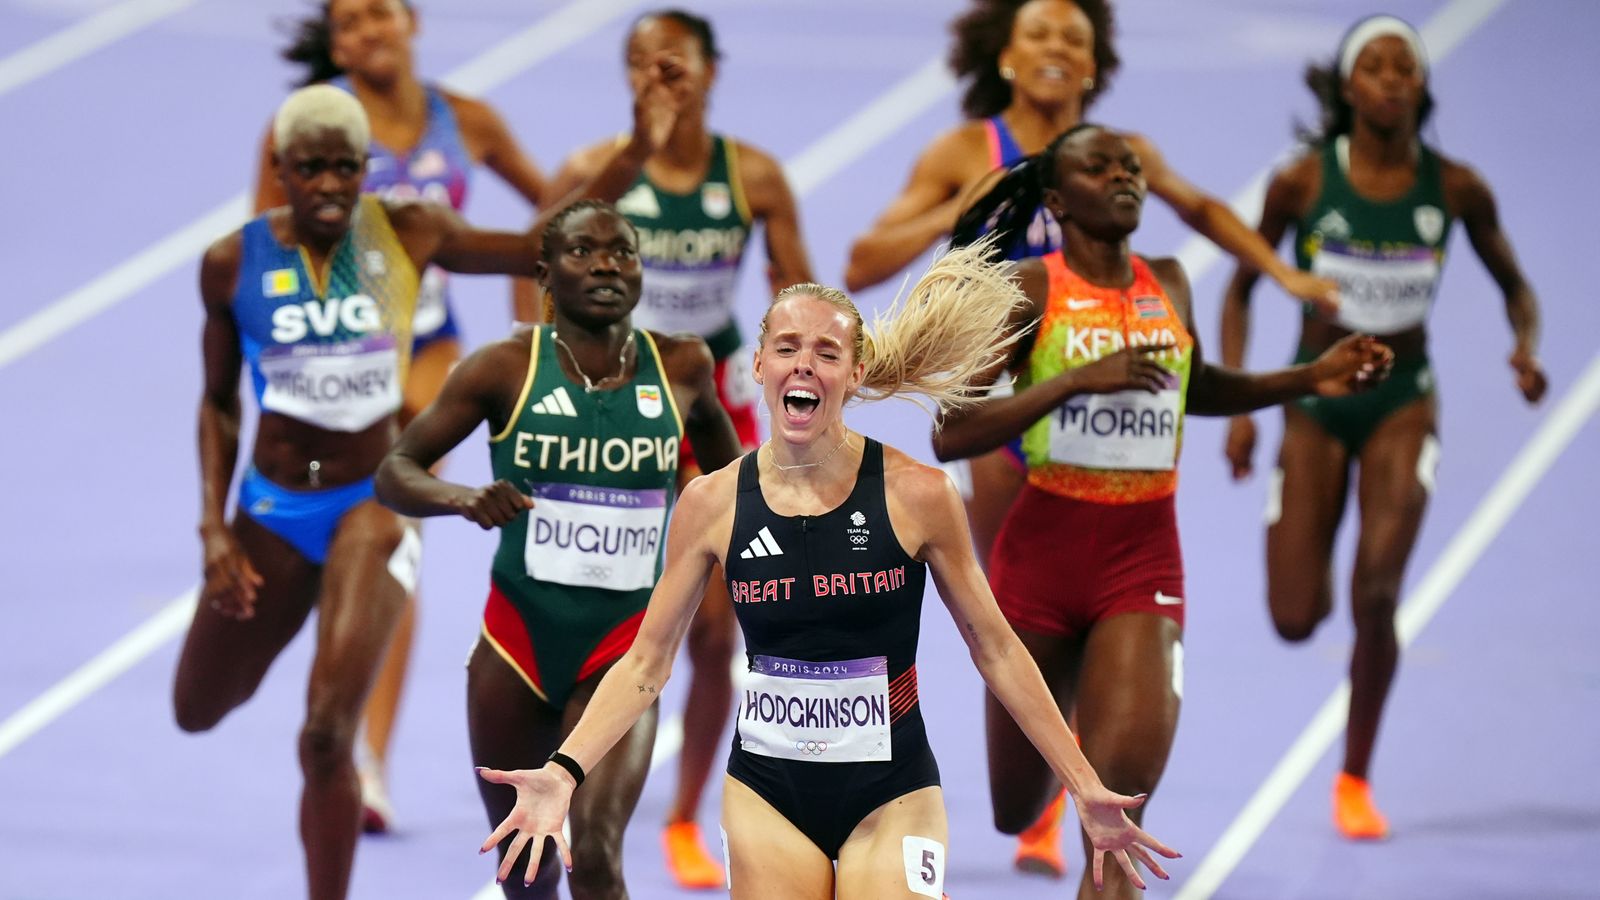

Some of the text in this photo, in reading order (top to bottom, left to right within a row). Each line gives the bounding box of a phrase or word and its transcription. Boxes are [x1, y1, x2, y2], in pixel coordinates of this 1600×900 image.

[272, 294, 382, 343] SVG
[1060, 404, 1174, 438] MORAA
[513, 431, 679, 472] ETHIOPIA
[569, 489, 641, 505] PARIS 2024
[535, 517, 658, 556] DUGUMA
[731, 565, 905, 603] GREAT BRITAIN
[774, 662, 848, 675] PARIS 2024
[745, 689, 886, 729] HODGKINSON
[920, 849, 937, 885] 5
